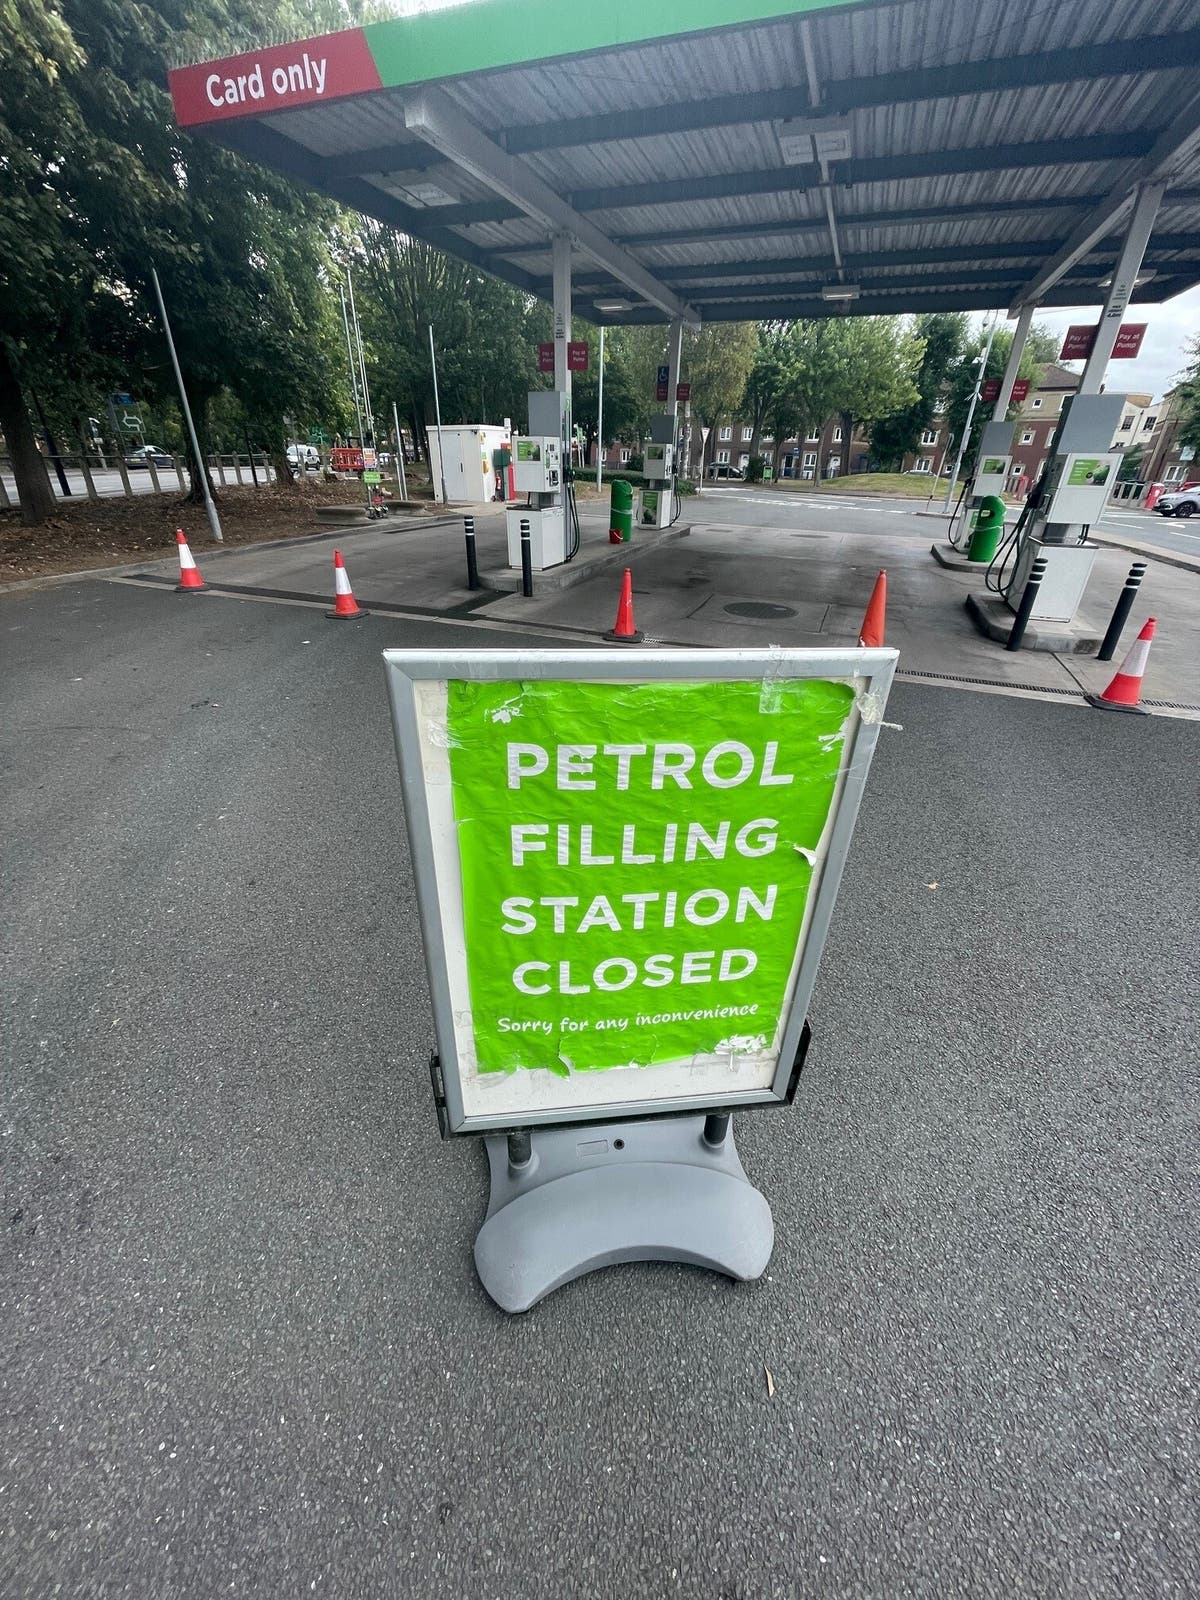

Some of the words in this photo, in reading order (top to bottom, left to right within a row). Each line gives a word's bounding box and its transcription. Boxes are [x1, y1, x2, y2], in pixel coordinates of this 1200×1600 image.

[206, 63, 265, 107] Card
[271, 53, 327, 94] only
[1118, 333, 1131, 341] Pay
[506, 740, 795, 791] PETROL
[510, 818, 780, 867] FILLING
[501, 884, 778, 935] STATION
[512, 948, 758, 995] CLOSED
[497, 1017, 553, 1035] Sorry
[560, 1017, 589, 1033] for
[595, 1017, 629, 1031] any
[635, 1003, 759, 1026] inconvenience
